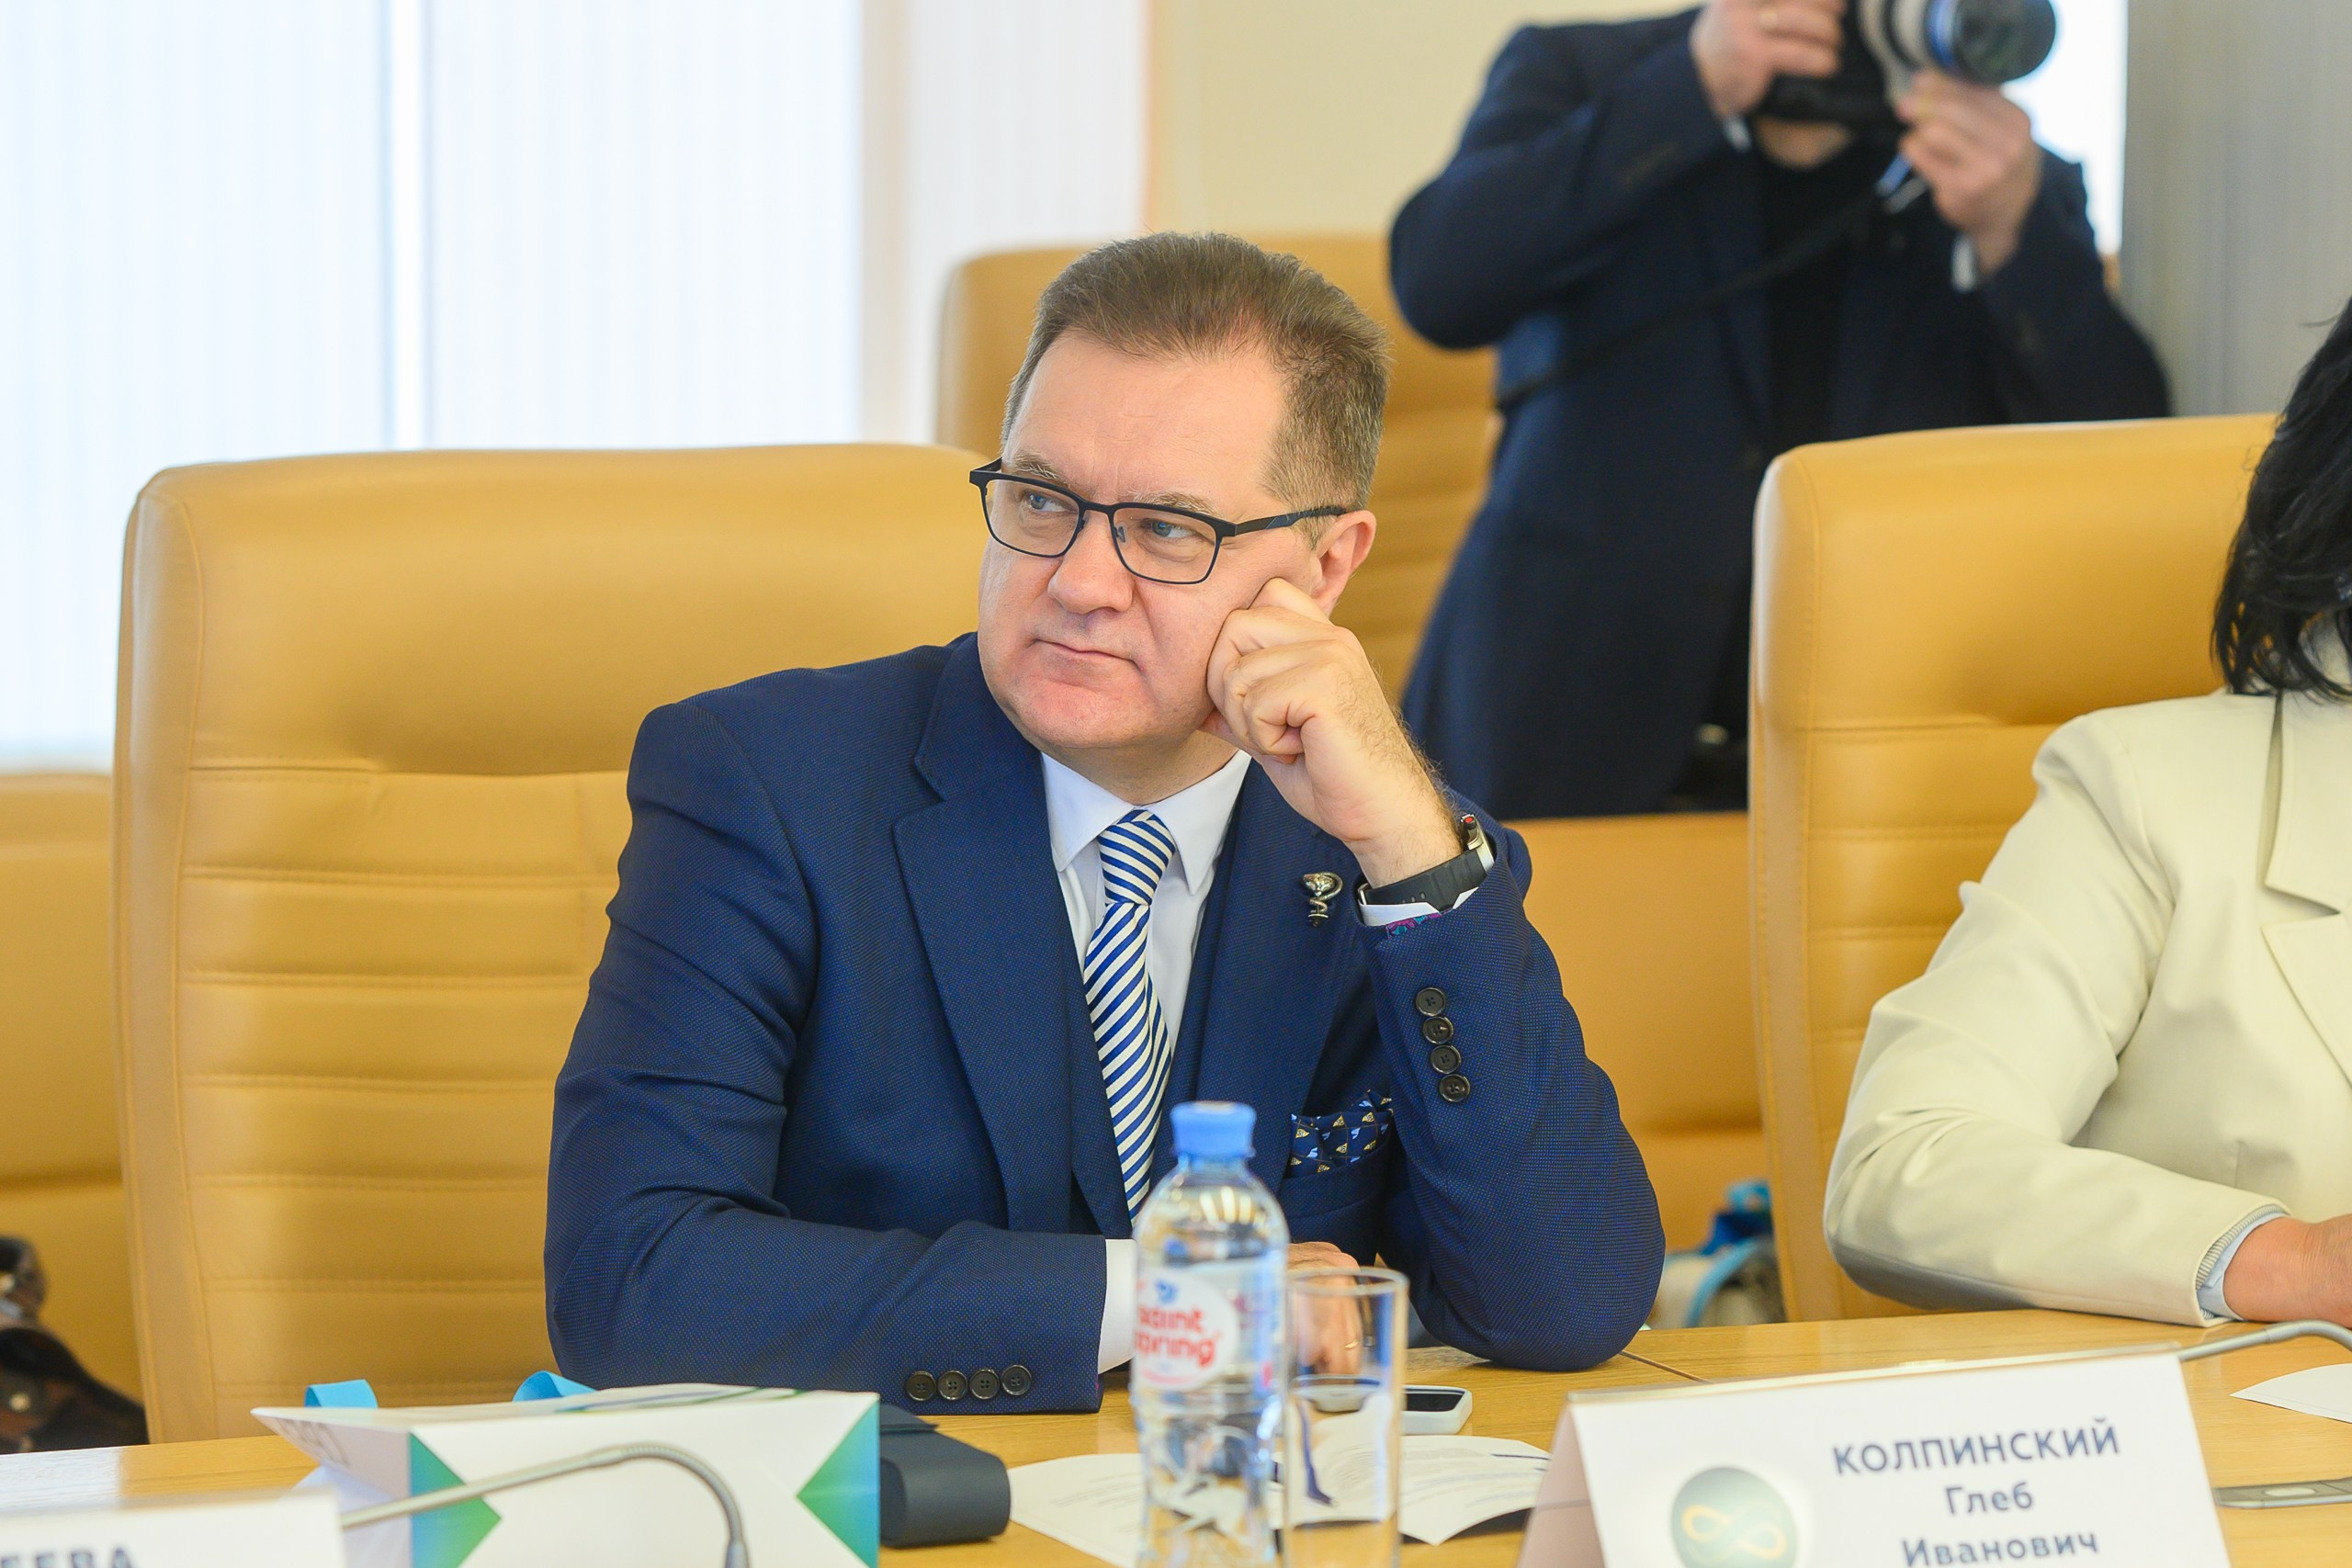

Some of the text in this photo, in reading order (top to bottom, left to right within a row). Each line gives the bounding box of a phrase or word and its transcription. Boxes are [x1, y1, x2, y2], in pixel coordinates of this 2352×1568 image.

[1135, 1331, 1215, 1368] pring
[1833, 1416, 2120, 1474] КОЛПИНСКИЙ
[1944, 1481, 2033, 1515] Глеб
[1901, 1532, 2099, 1567] Иванович
